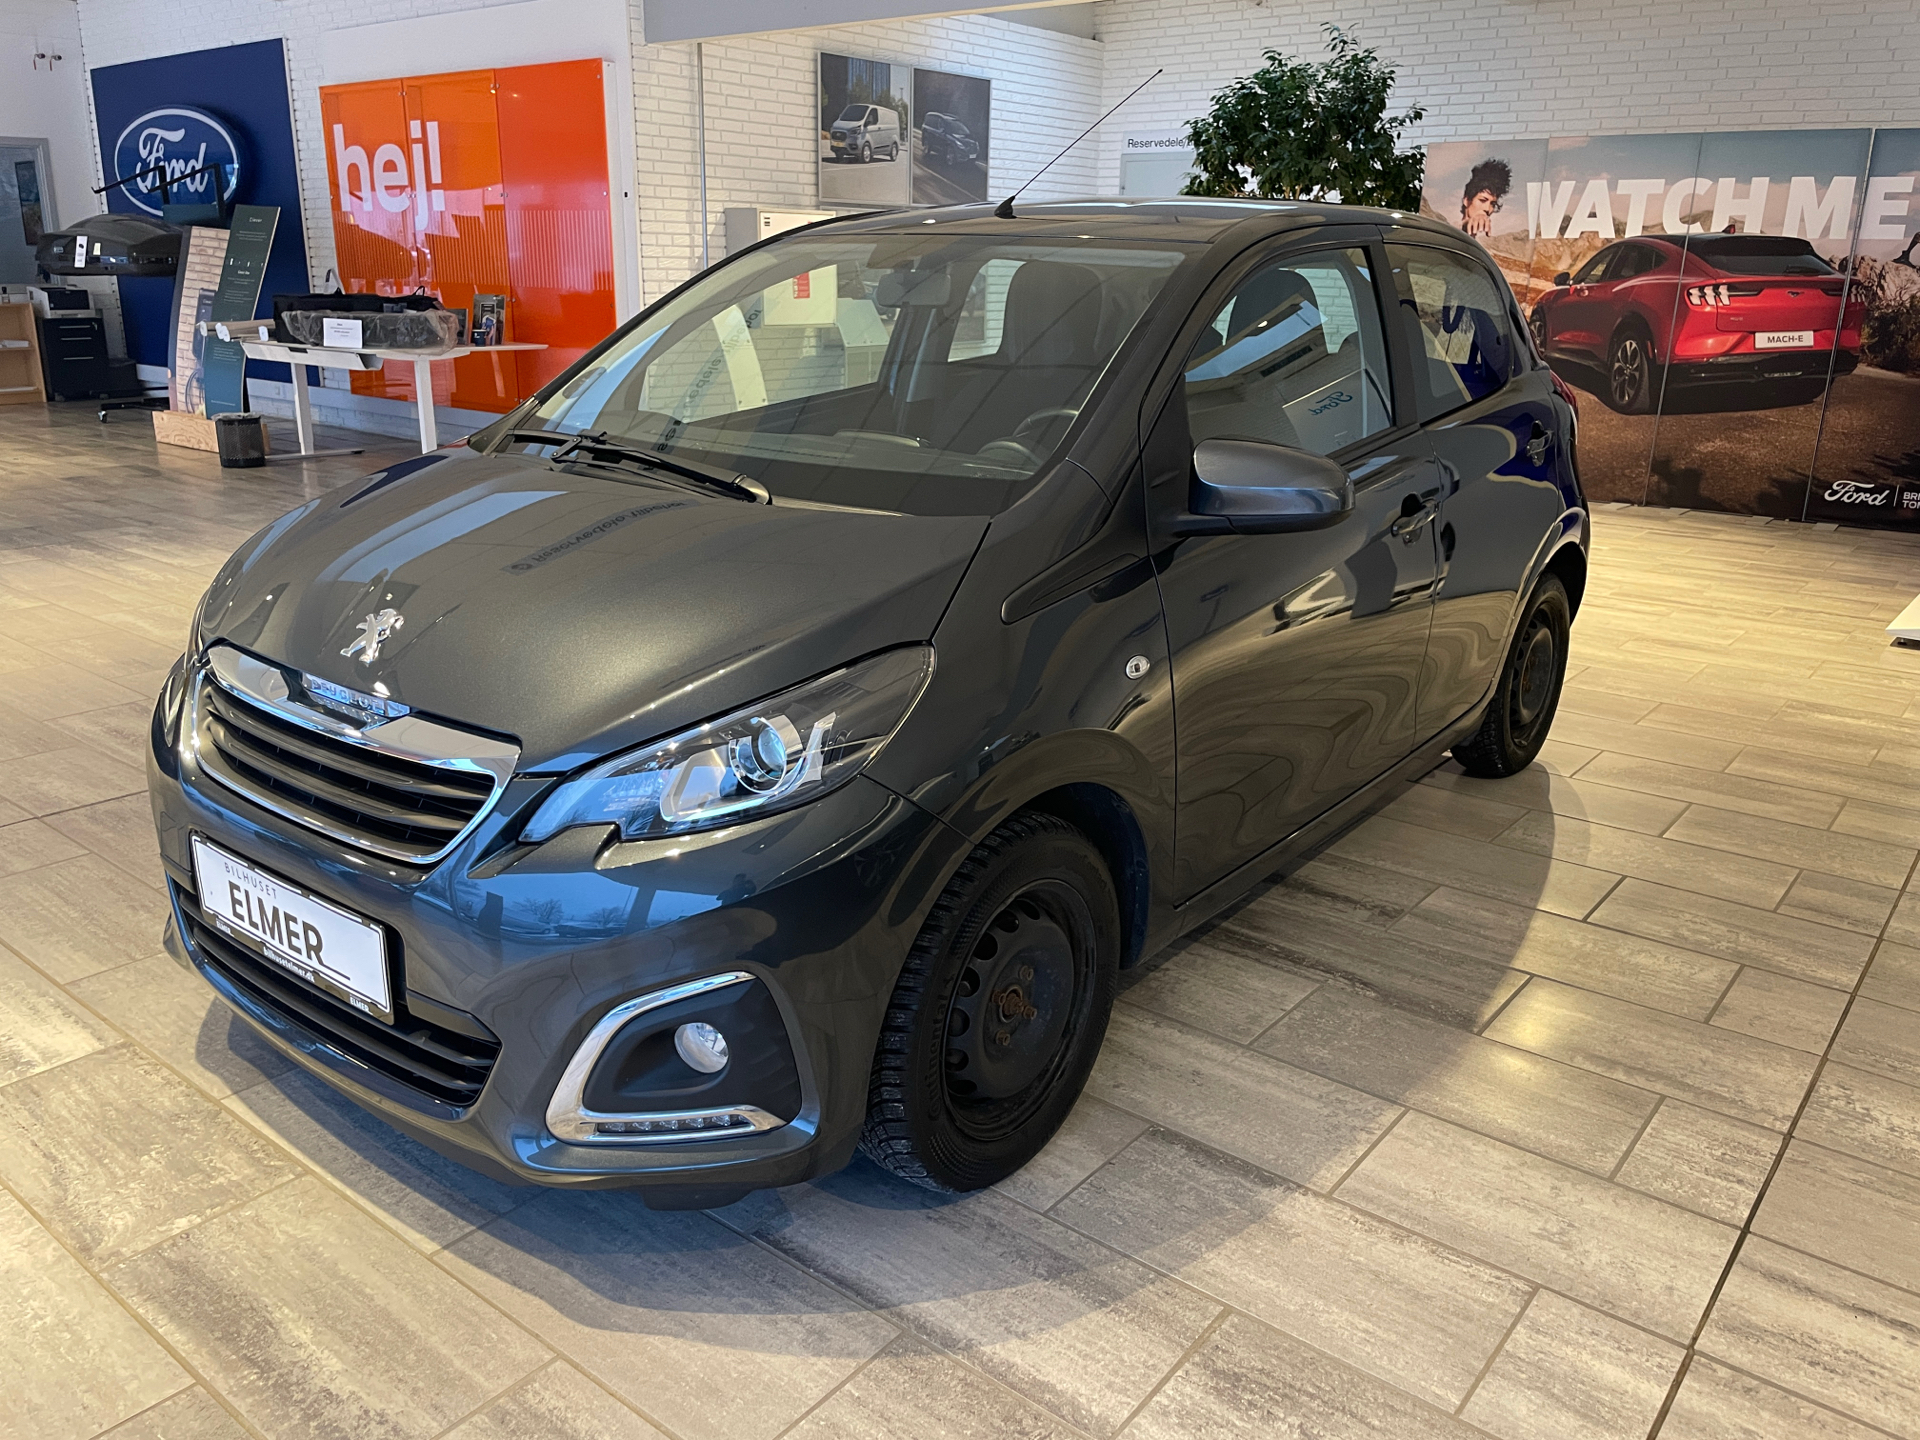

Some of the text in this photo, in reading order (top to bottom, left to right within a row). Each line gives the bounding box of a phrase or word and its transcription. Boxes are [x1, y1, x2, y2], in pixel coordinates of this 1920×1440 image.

[333, 120, 445, 231] hej!
[1526, 175, 1915, 240] WATCH ME
[1767, 334, 1804, 344] MACH-E
[1823, 480, 1891, 506] Ford
[311, 678, 386, 714] PEUGEOT
[224, 861, 277, 900] BILHUSET
[228, 879, 326, 968] ELMER
